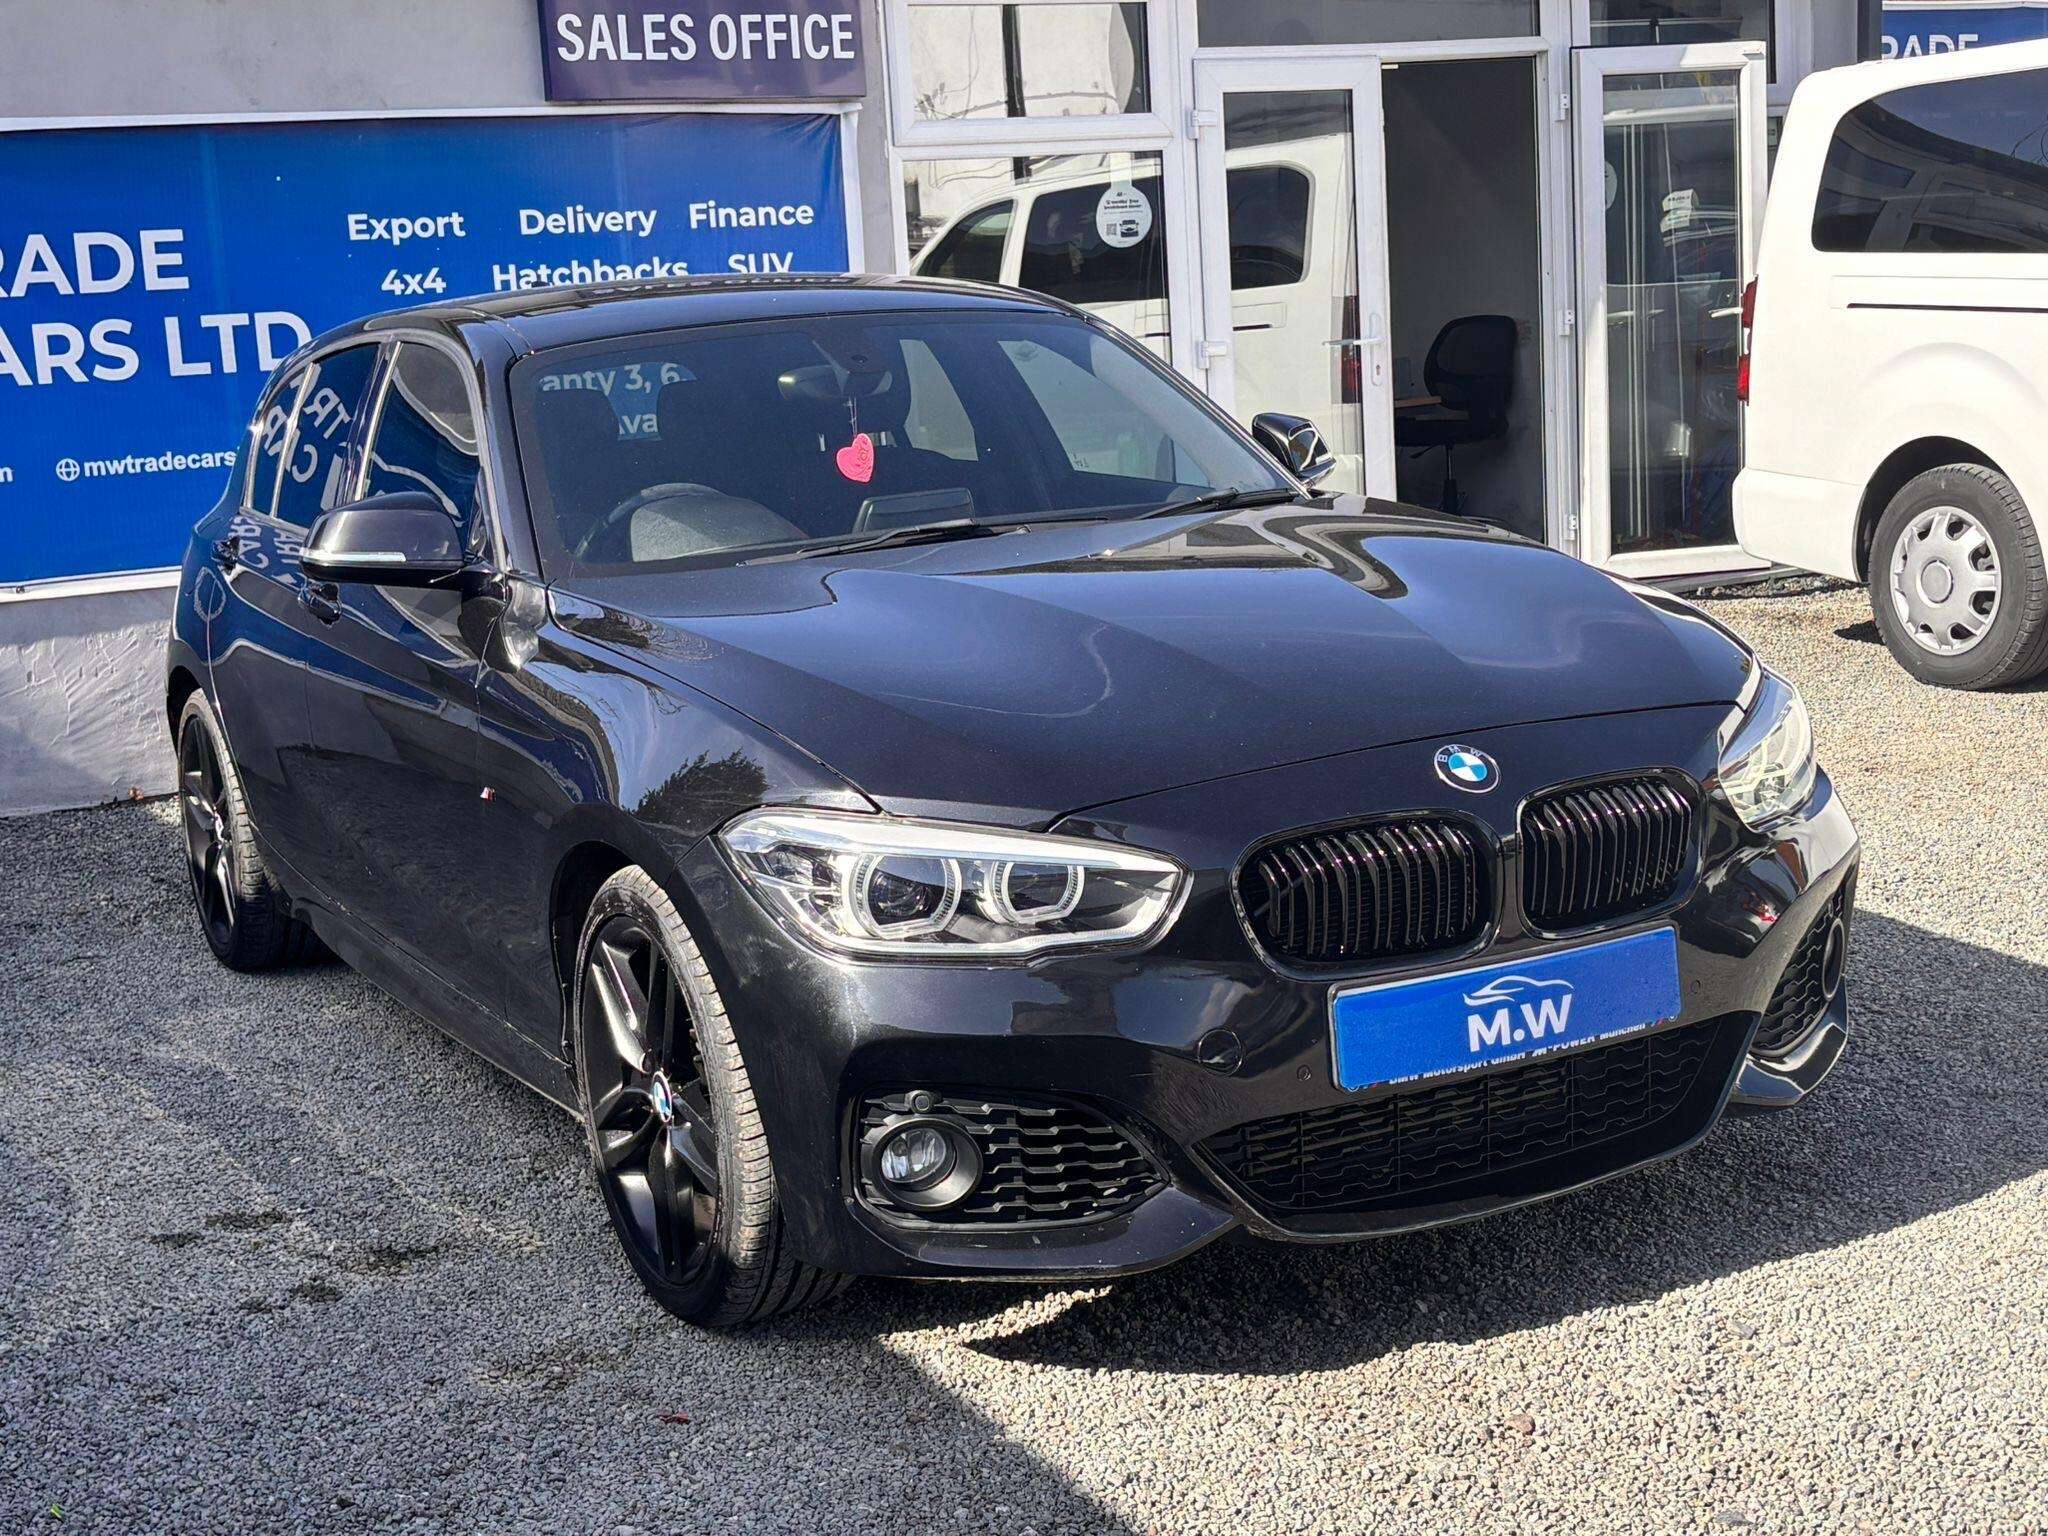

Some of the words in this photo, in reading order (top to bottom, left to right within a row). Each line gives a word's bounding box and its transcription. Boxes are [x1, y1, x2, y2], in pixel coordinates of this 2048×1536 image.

[557, 14, 697, 61] SALES
[709, 14, 855, 60] OFFICE
[347, 212, 467, 246] Export
[519, 205, 657, 237] Delivery
[689, 200, 814, 229] Finance
[0, 229, 190, 298] ADE
[381, 267, 447, 296] 4x4
[493, 256, 689, 291] Hatchbacks
[728, 252, 794, 274] SUV
[164, 311, 312, 377] LTD
[624, 363, 652, 394] 3,
[84, 450, 237, 477] mwtradecars
[1467, 993, 1573, 1053] M.W
